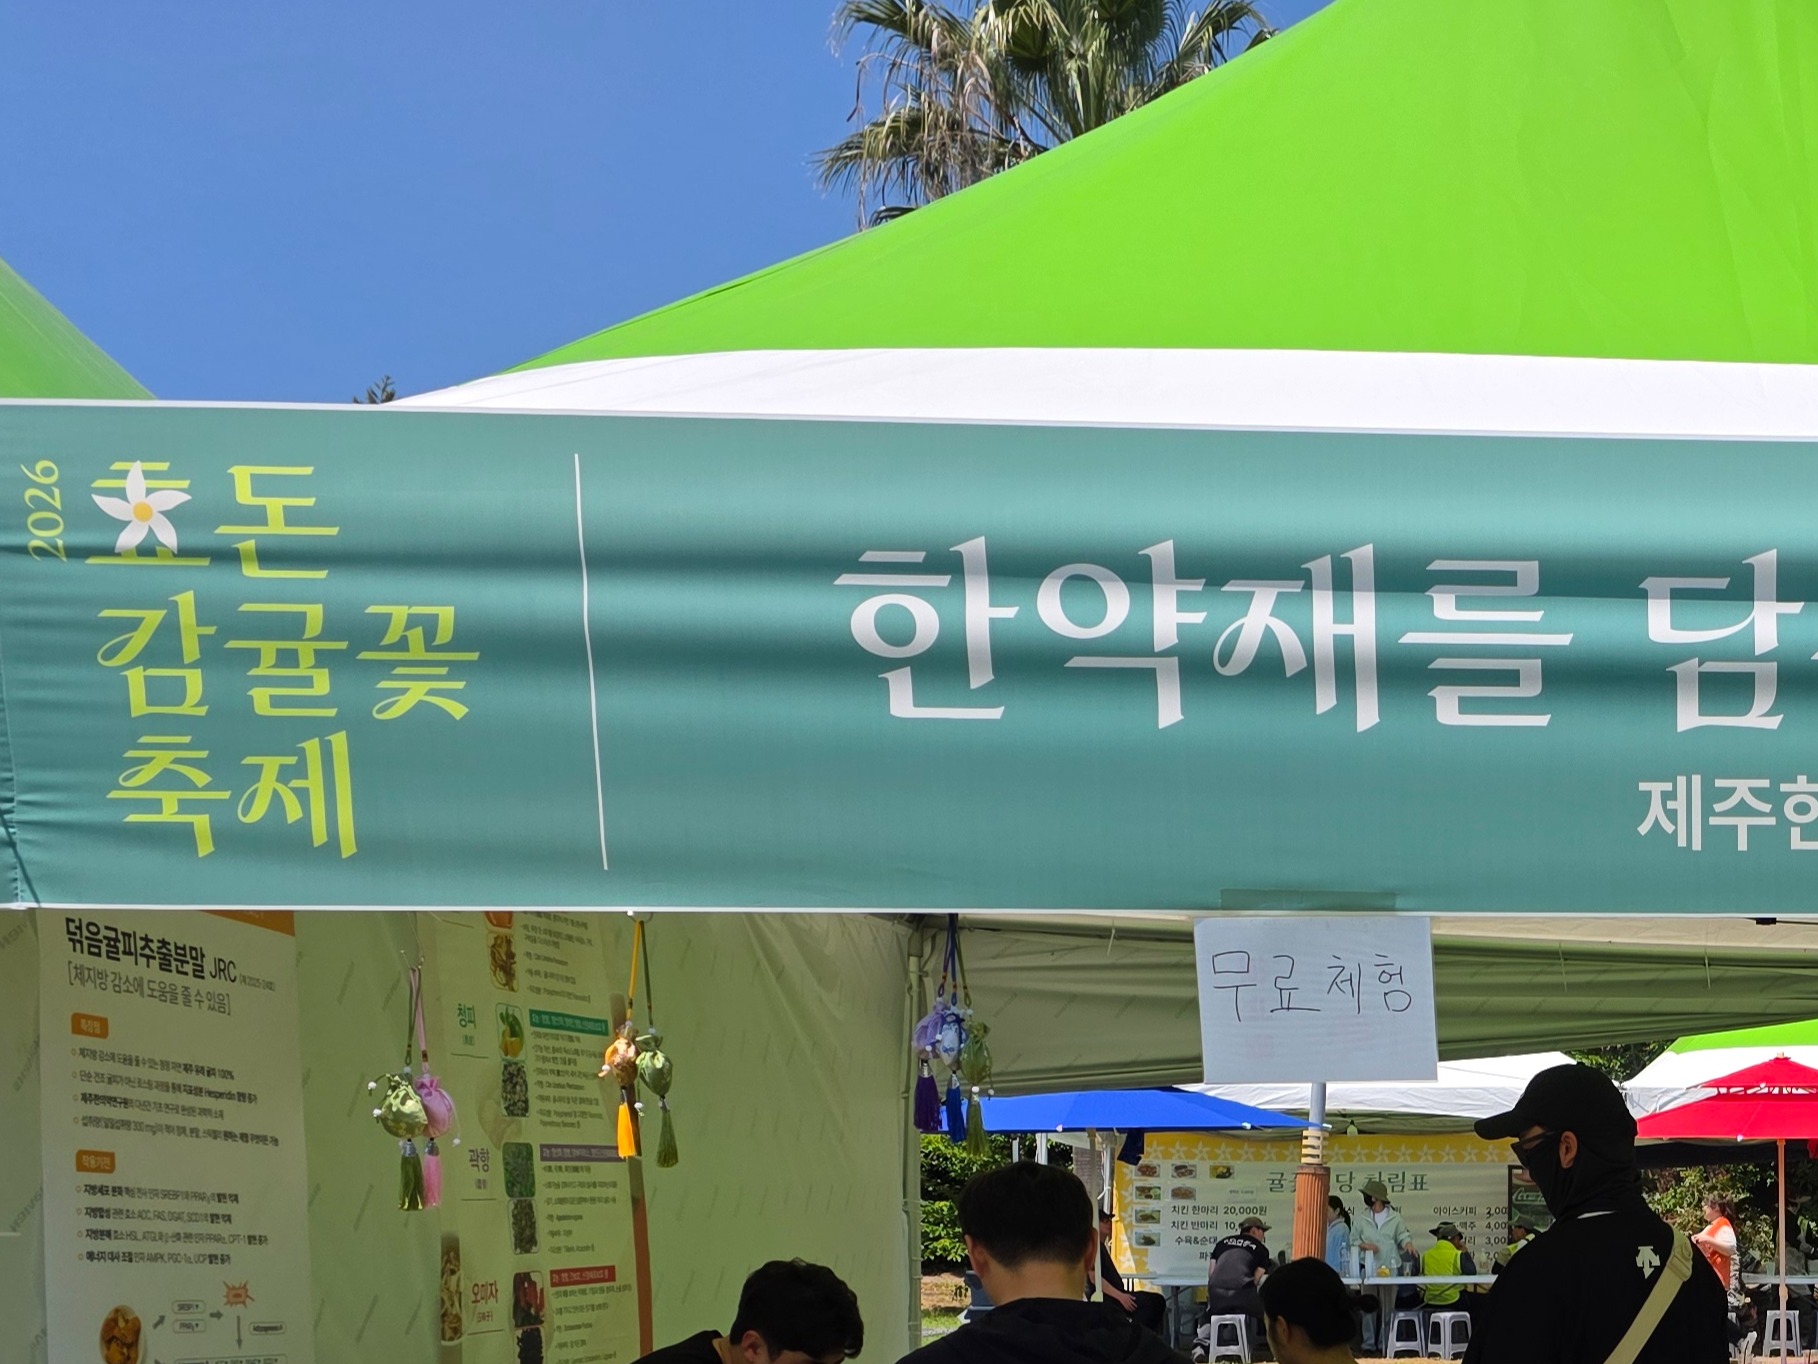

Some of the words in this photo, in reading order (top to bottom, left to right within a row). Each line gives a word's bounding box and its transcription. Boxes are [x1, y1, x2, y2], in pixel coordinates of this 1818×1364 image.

[20, 460, 68, 562] 2026
[96, 590, 480, 721] 감귤꽃
[833, 535, 1574, 732] 한약재를
[105, 730, 357, 859] 축제
[65, 917, 206, 980] 덖음귤피추출분말
[209, 957, 237, 983] JRC
[112, 971, 145, 998] 감소에
[147, 979, 179, 1006] 도움을
[180, 985, 192, 1008] 줄
[194, 989, 205, 1011] 수
[1212, 950, 1321, 1022] 무료
[1327, 953, 1412, 1015] 체험
[1171, 1220, 1188, 1230] 치킨
[1172, 1205, 1189, 1215] 치킨
[1192, 1205, 1219, 1215] 한마리
[1223, 1205, 1268, 1216] 20,000원
[471, 1280, 499, 1305] 오미자
